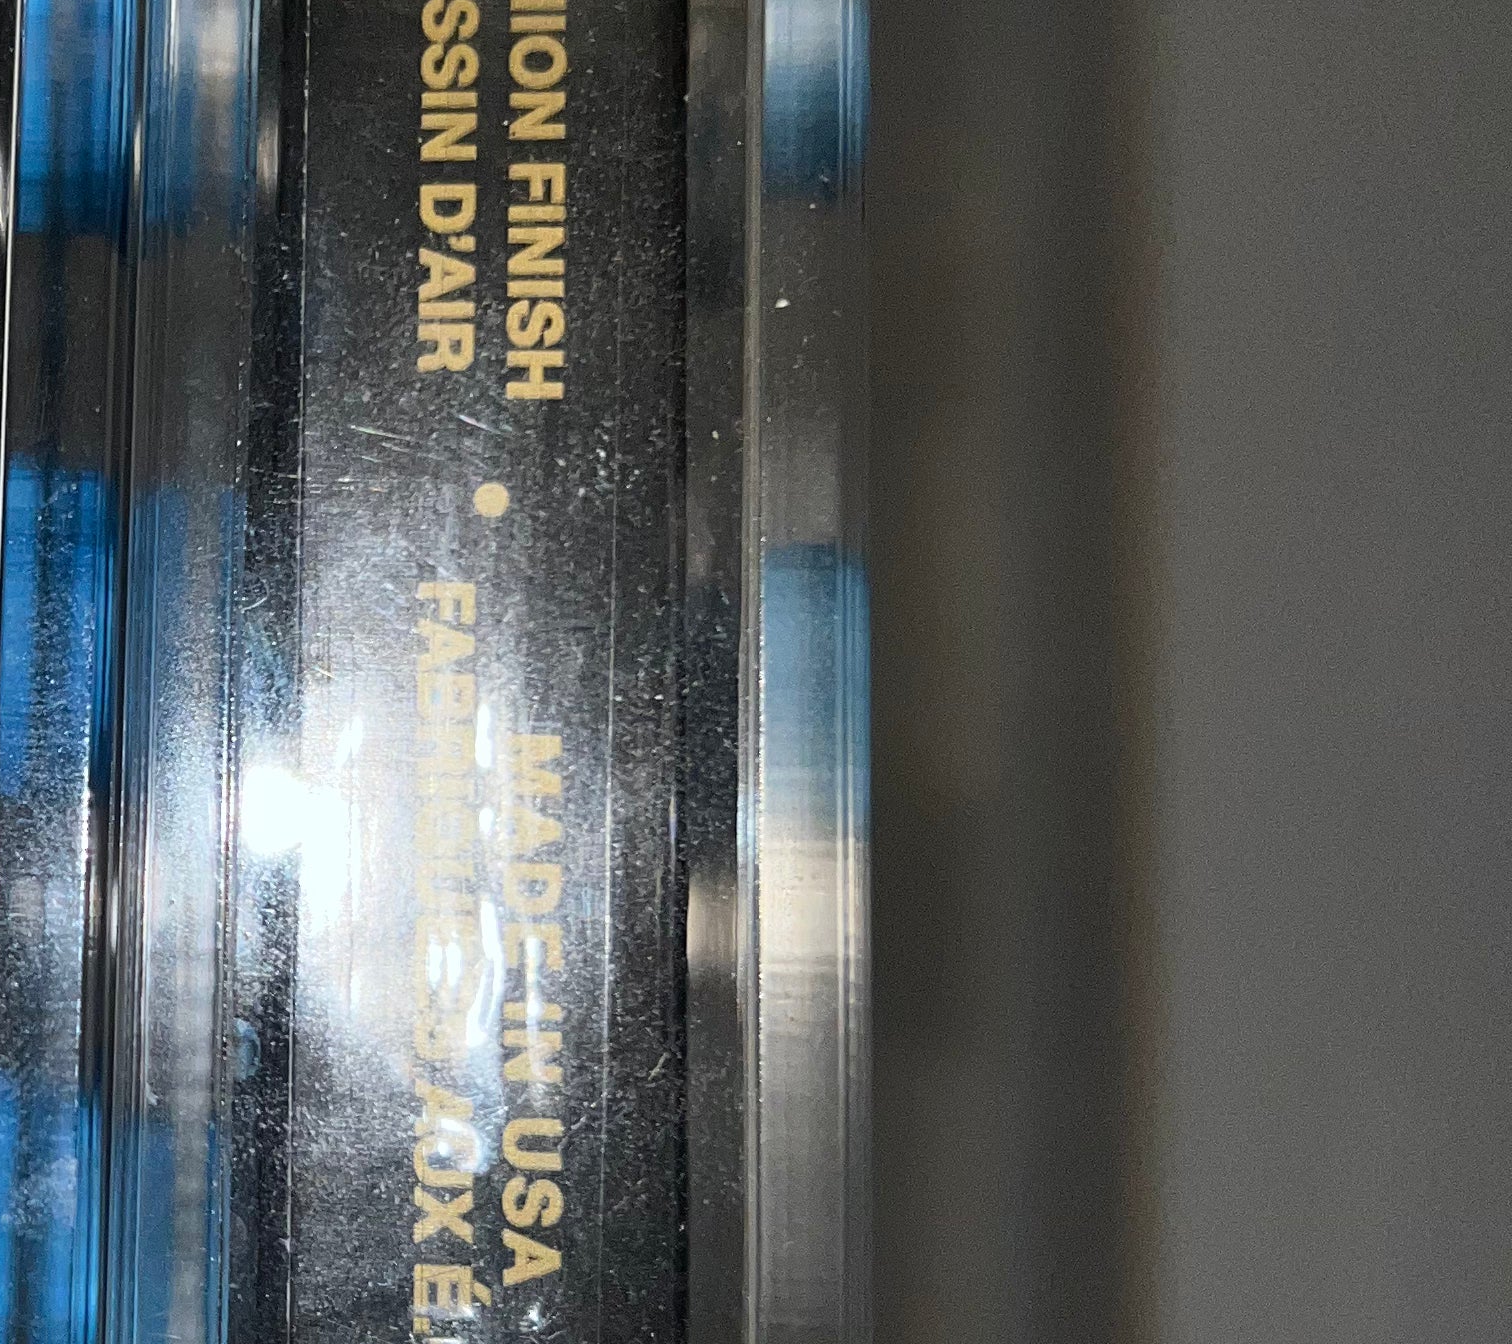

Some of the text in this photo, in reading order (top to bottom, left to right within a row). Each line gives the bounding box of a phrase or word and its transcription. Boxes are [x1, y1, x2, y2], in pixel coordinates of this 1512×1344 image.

[416, 183, 478, 374] D'AIR
[505, 162, 567, 401] FINISH
[502, 733, 565, 1288] MADE IN USA
[413, 1077, 476, 1246] AUX
